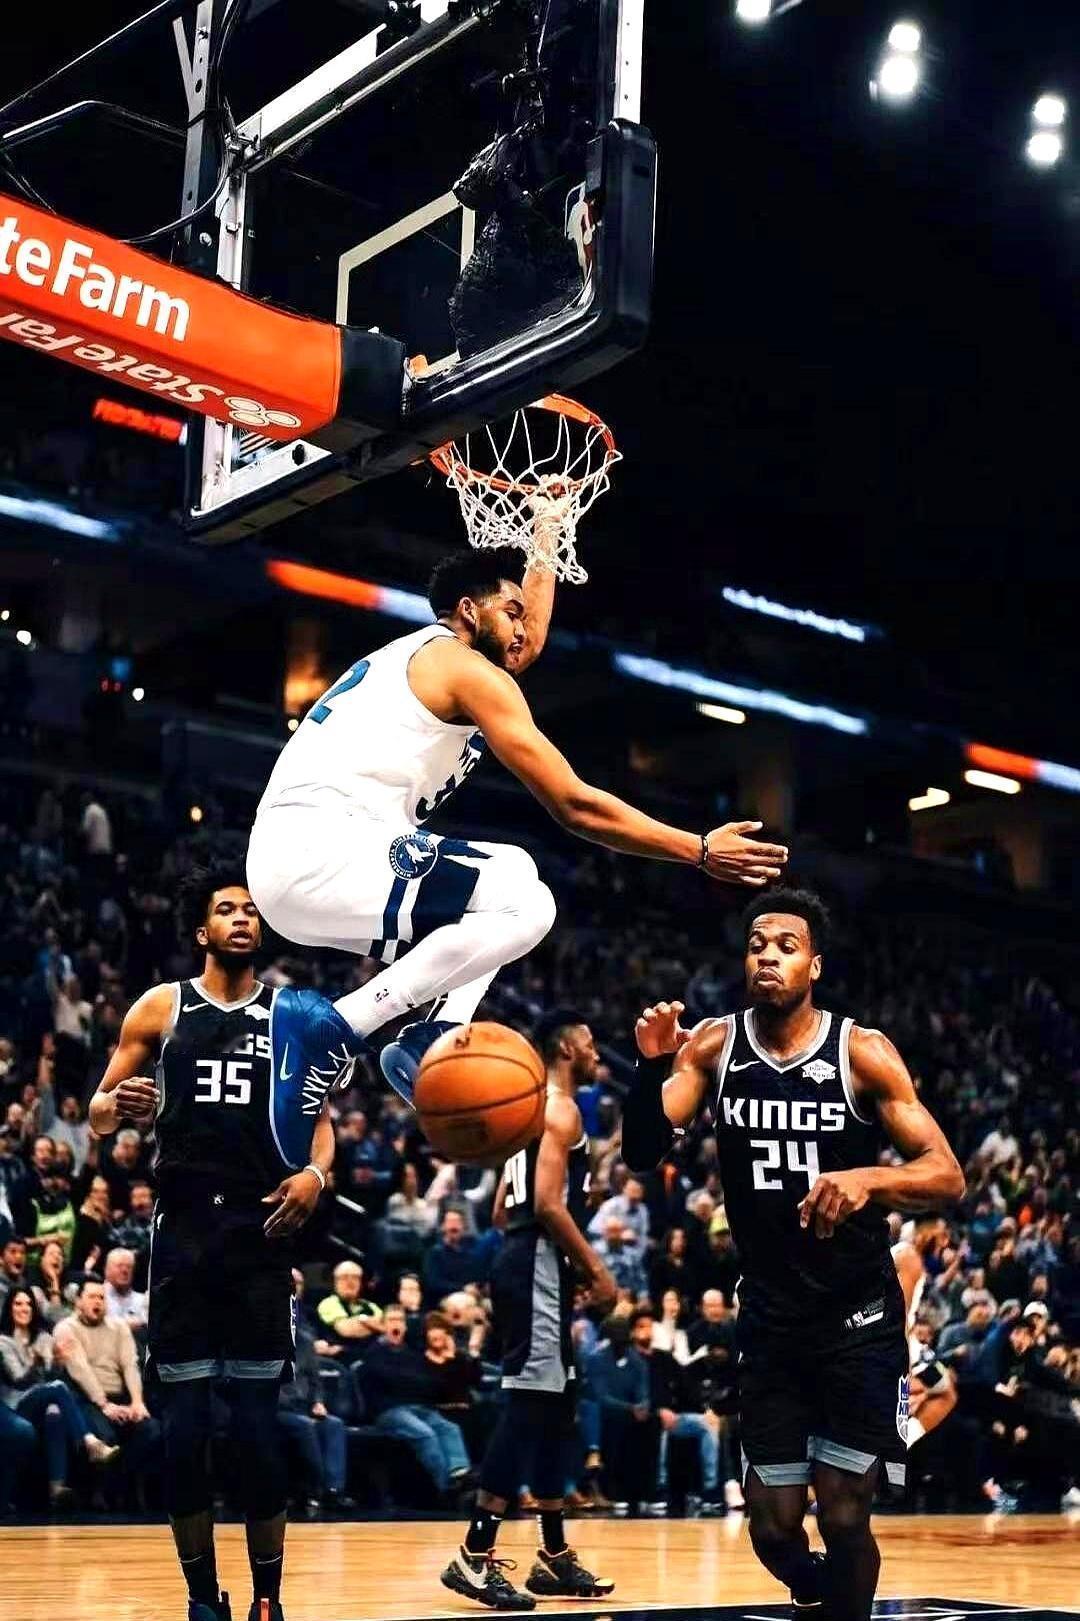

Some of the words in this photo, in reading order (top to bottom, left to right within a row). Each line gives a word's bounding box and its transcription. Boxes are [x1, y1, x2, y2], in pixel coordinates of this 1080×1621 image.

[195, 1060, 252, 1105] 35
[722, 1097, 846, 1131] KINGS
[750, 1139, 820, 1190] 24
